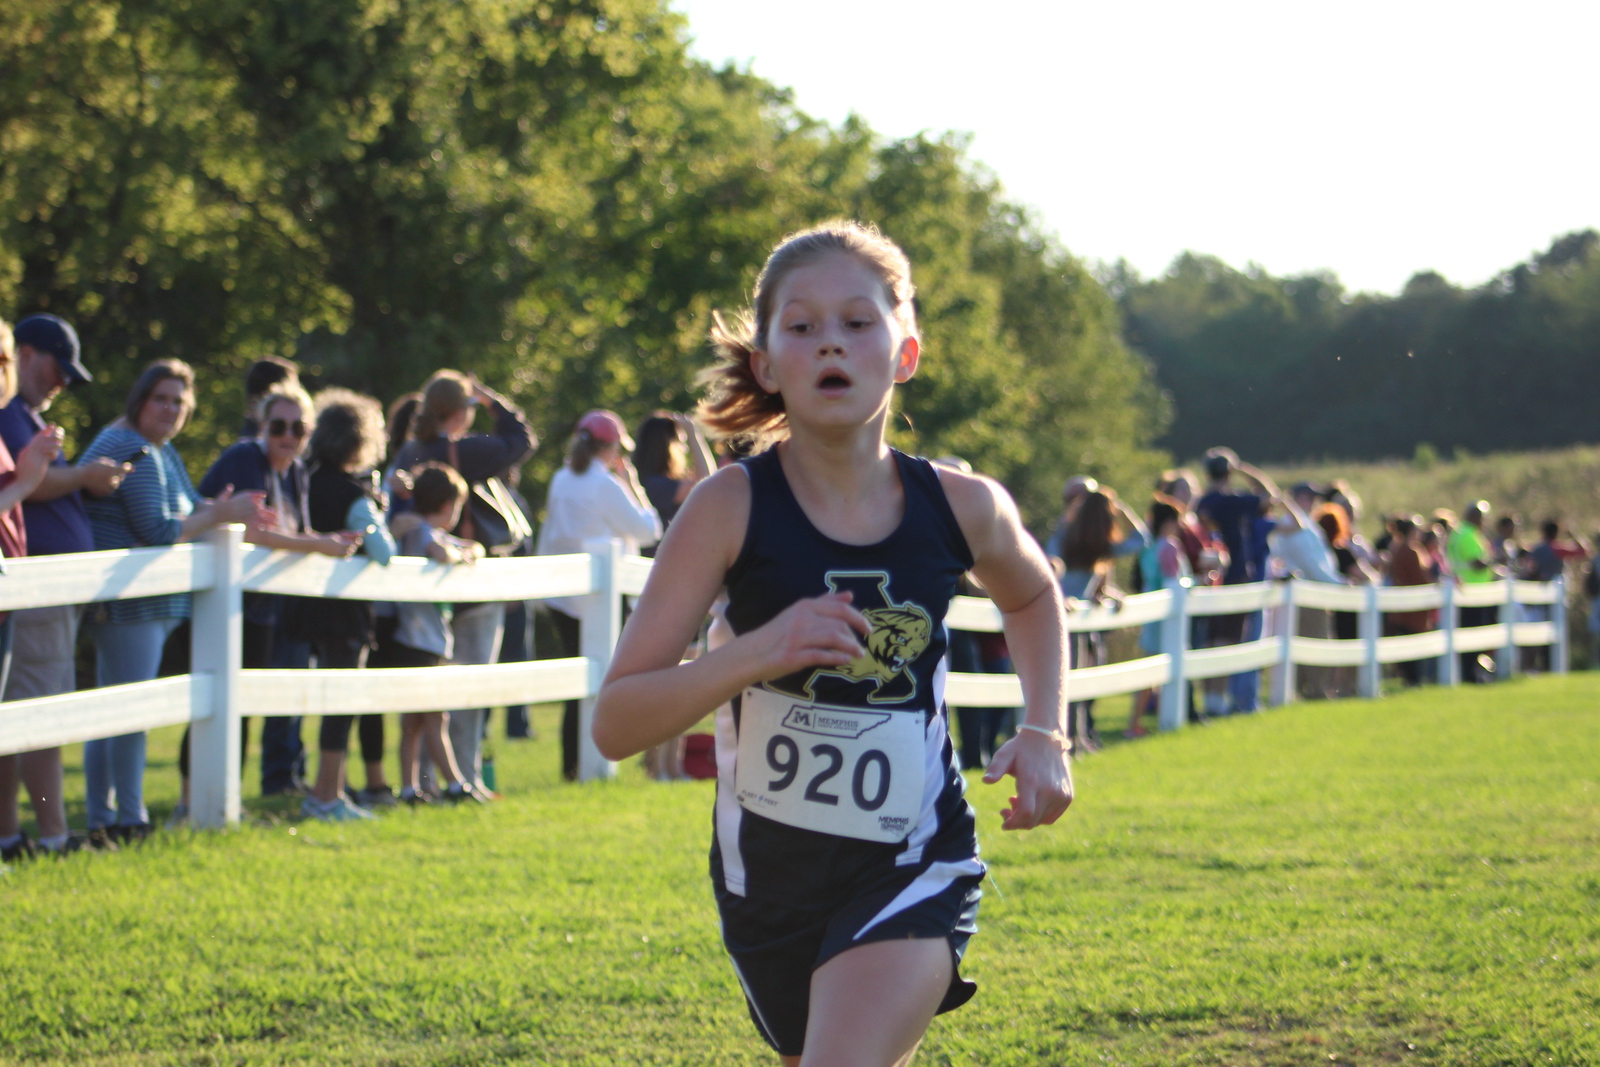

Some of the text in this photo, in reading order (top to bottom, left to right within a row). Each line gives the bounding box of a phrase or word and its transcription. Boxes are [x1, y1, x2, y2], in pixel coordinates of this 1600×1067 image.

[793, 711, 810, 726] M
[818, 717, 858, 728] MEMPHIS
[766, 734, 892, 812] 920
[741, 789, 758, 799] FLEET
[764, 798, 779, 807] FEET
[878, 816, 909, 825] MEMPHIS
